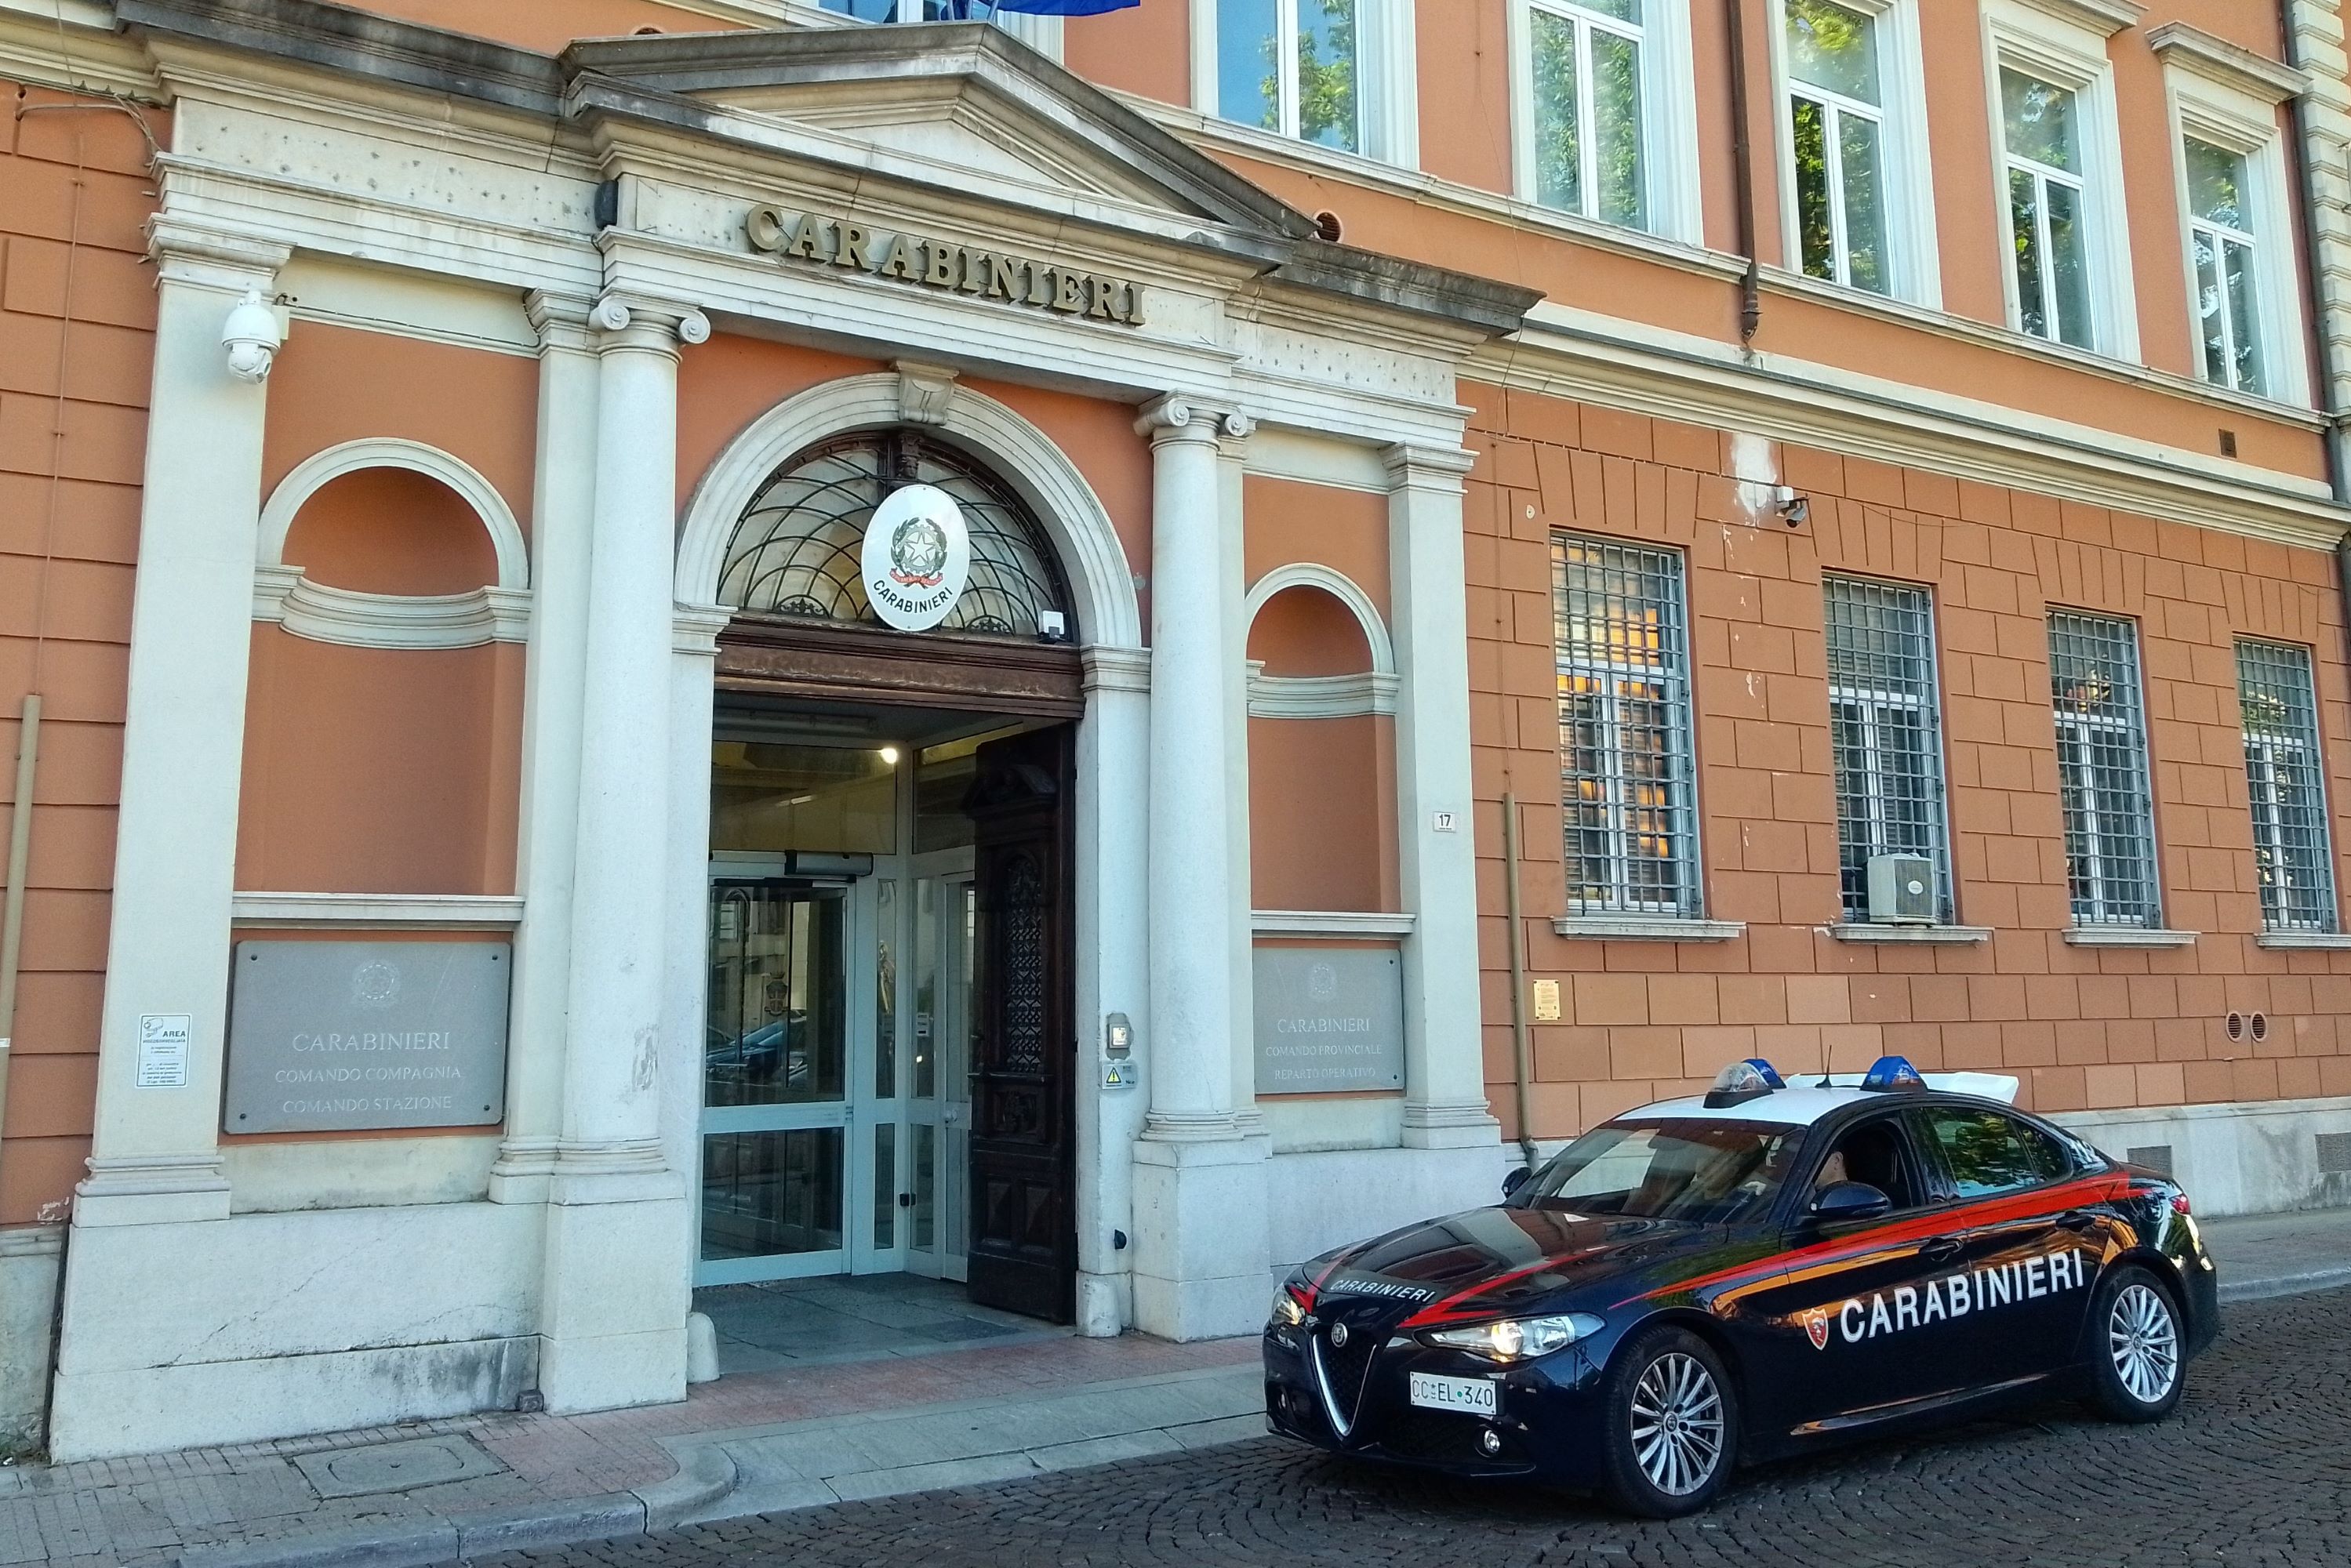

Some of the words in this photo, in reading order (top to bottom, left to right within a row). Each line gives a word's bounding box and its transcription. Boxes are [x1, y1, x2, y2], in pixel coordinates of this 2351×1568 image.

[745, 203, 1146, 326] CARABINIERI
[873, 579, 954, 614] CARABINIERI
[1439, 814, 1451, 826] 17
[1277, 1018, 1371, 1033] CARABINIERI
[292, 1032, 451, 1051] CARABINIERI
[1266, 1046, 1316, 1056] COMANDO
[1319, 1044, 1383, 1055] PROVINCIALE
[275, 1068, 362, 1083] COMANDO
[365, 1066, 461, 1080] COMPAGNIA
[1275, 1069, 1319, 1080] REPARTO
[1321, 1067, 1375, 1078] OPERATIVO
[283, 1098, 369, 1113] COMANDO
[374, 1096, 452, 1110] STAZIONE
[1329, 1279, 1436, 1302] CARABINIERI
[1840, 1247, 2084, 1343] CARABINIERI
[1412, 1380, 1429, 1399] CC
[1437, 1382, 1455, 1403] EL
[1463, 1385, 1493, 1407] 340
